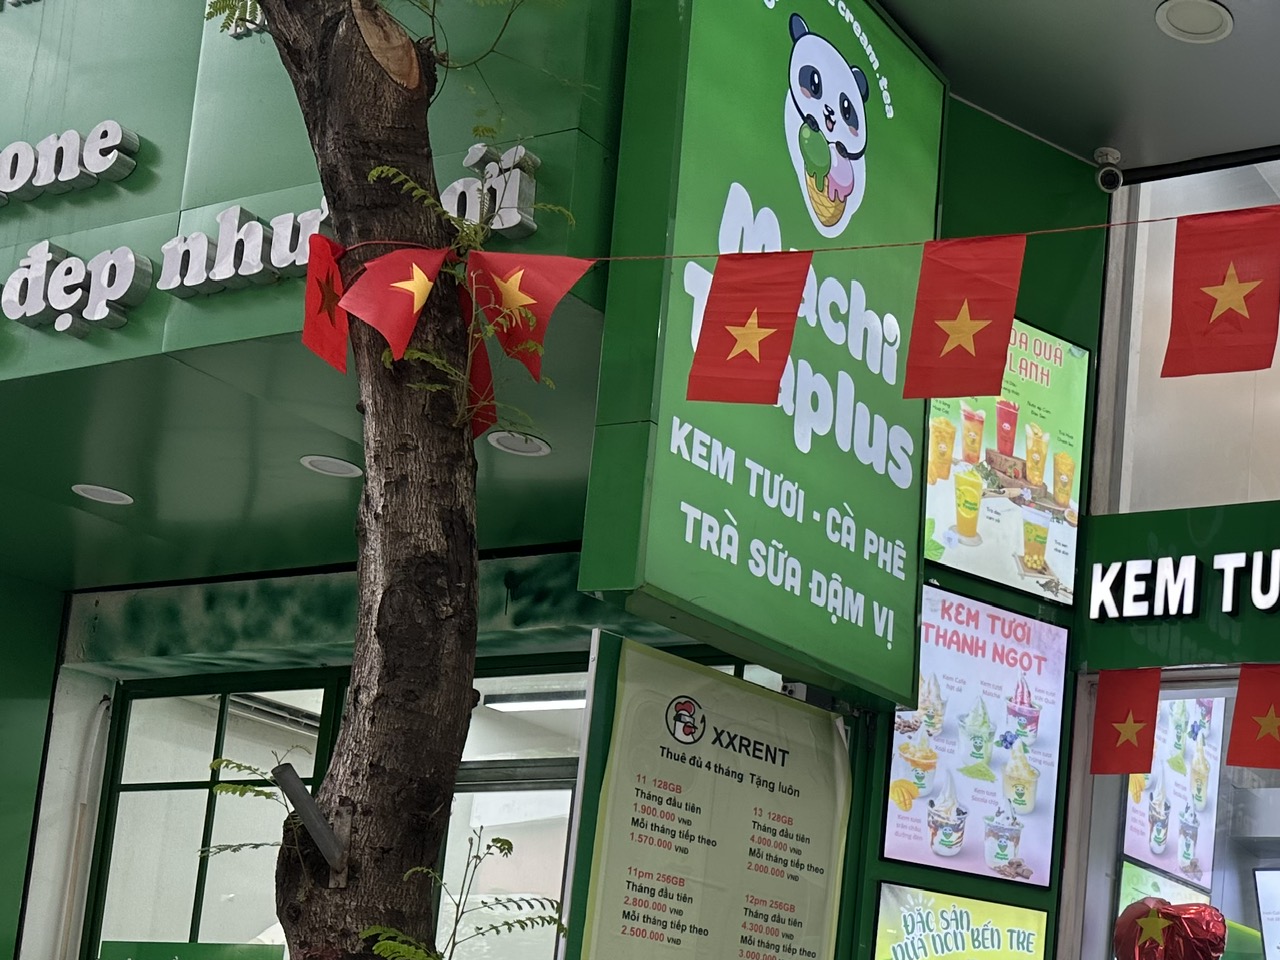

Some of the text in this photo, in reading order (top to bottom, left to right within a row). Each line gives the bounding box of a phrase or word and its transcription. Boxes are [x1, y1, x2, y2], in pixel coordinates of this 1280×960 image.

[0, 119, 130, 196] one
[1, 240, 140, 333] đẹp
[441, 143, 530, 231] ới
[1033, 339, 1063, 367] QUẢ
[670, 415, 736, 485] KEM
[745, 457, 805, 523] TƯƠI
[826, 502, 856, 552] CÀ
[863, 528, 907, 581] PHÊ
[680, 501, 895, 650] TRÀ SỮA ĐẬM VỊ
[1090, 554, 1196, 620] KEM
[941, 599, 1031, 645] KEM TƯƠI
[922, 621, 1047, 676] THANH NGỌT
[711, 726, 789, 767] XXRENT
[636, 774, 682, 794] 11 128GB
[659, 745, 800, 798] Thuê đủ 4 tháng Tặng luôn
[633, 802, 676, 822] 1.900.000
[635, 787, 702, 815] Tháng đầu tiên
[932, 930, 965, 954] NON
[971, 921, 1001, 949] BẾN
[1007, 929, 1036, 953] TRE
[940, 904, 970, 932] SẢN
